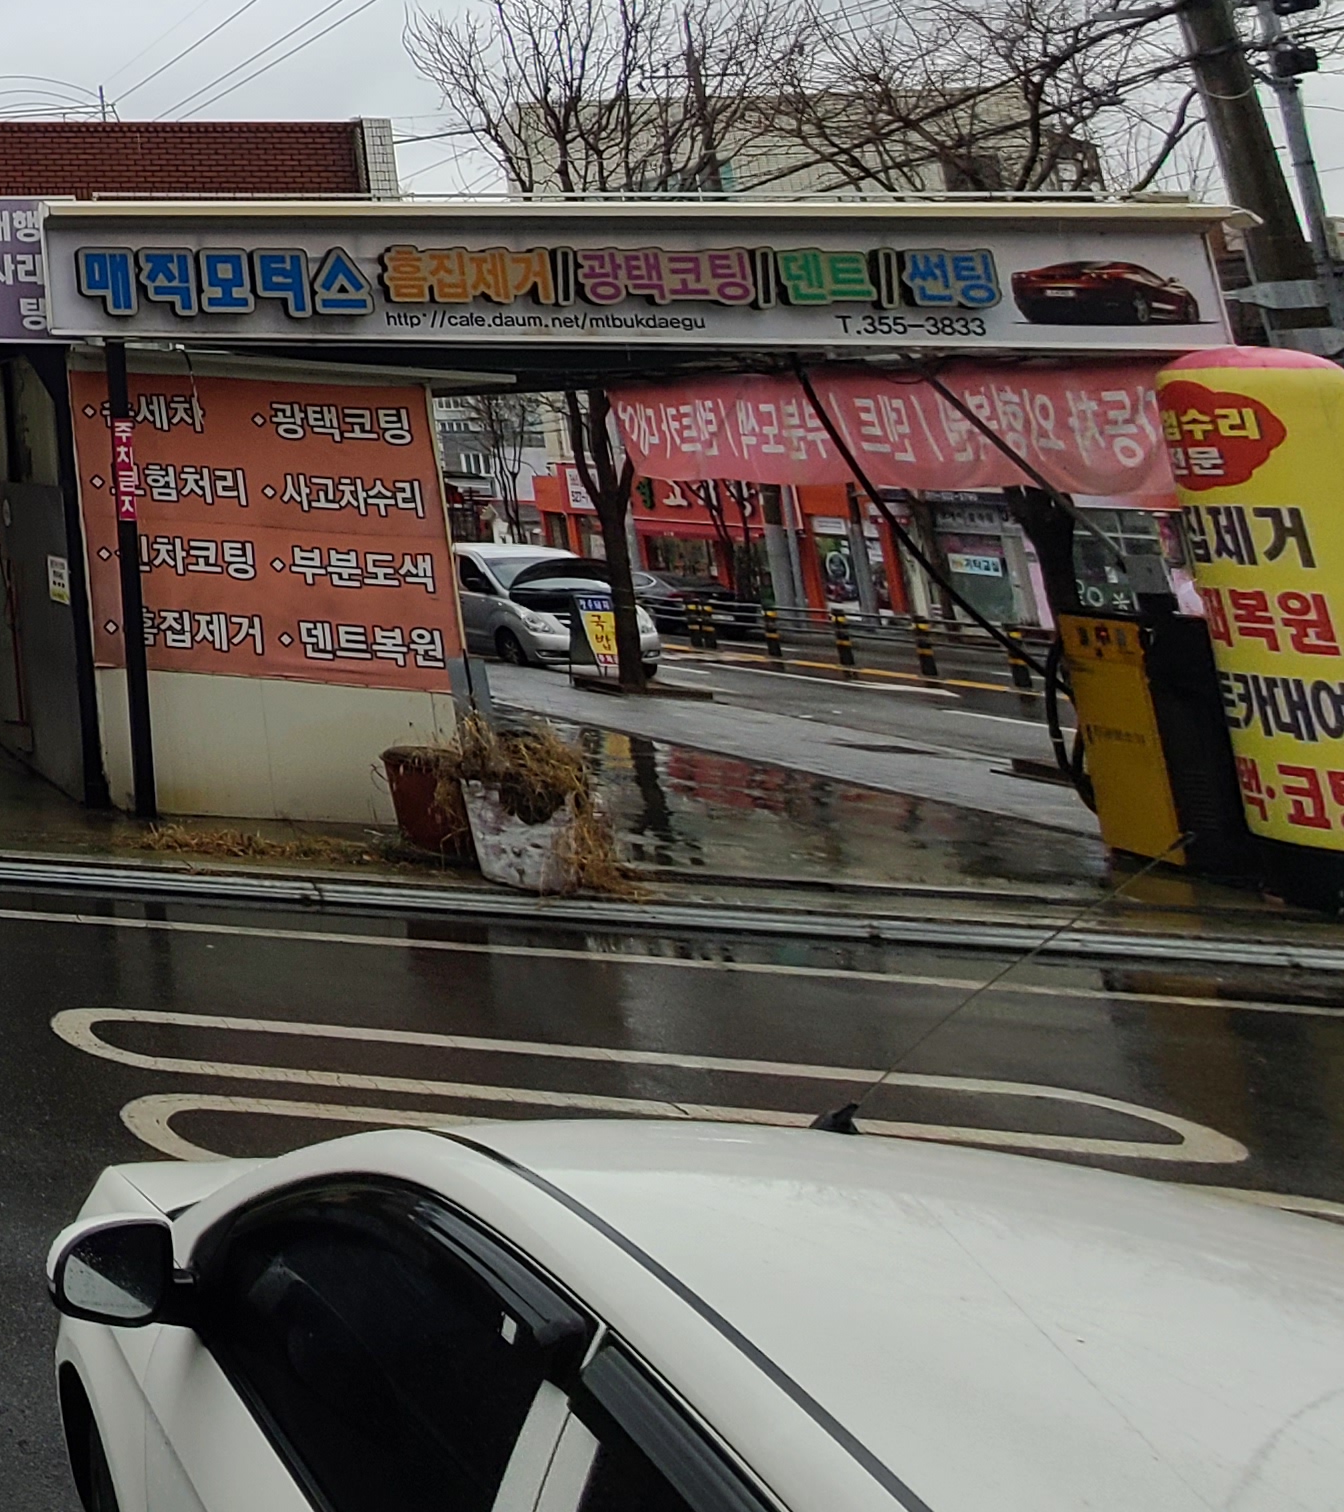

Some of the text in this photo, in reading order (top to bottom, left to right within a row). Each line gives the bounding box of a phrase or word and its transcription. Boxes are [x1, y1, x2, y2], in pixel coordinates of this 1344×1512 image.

[78, 247, 374, 317] 매직모터스
[836, 315, 988, 337] T.355-3833
[270, 401, 414, 446] 광택코팅
[280, 473, 426, 519] 사고차수리
[289, 545, 436, 594] 부분도색
[297, 619, 446, 670] 덴트복원
